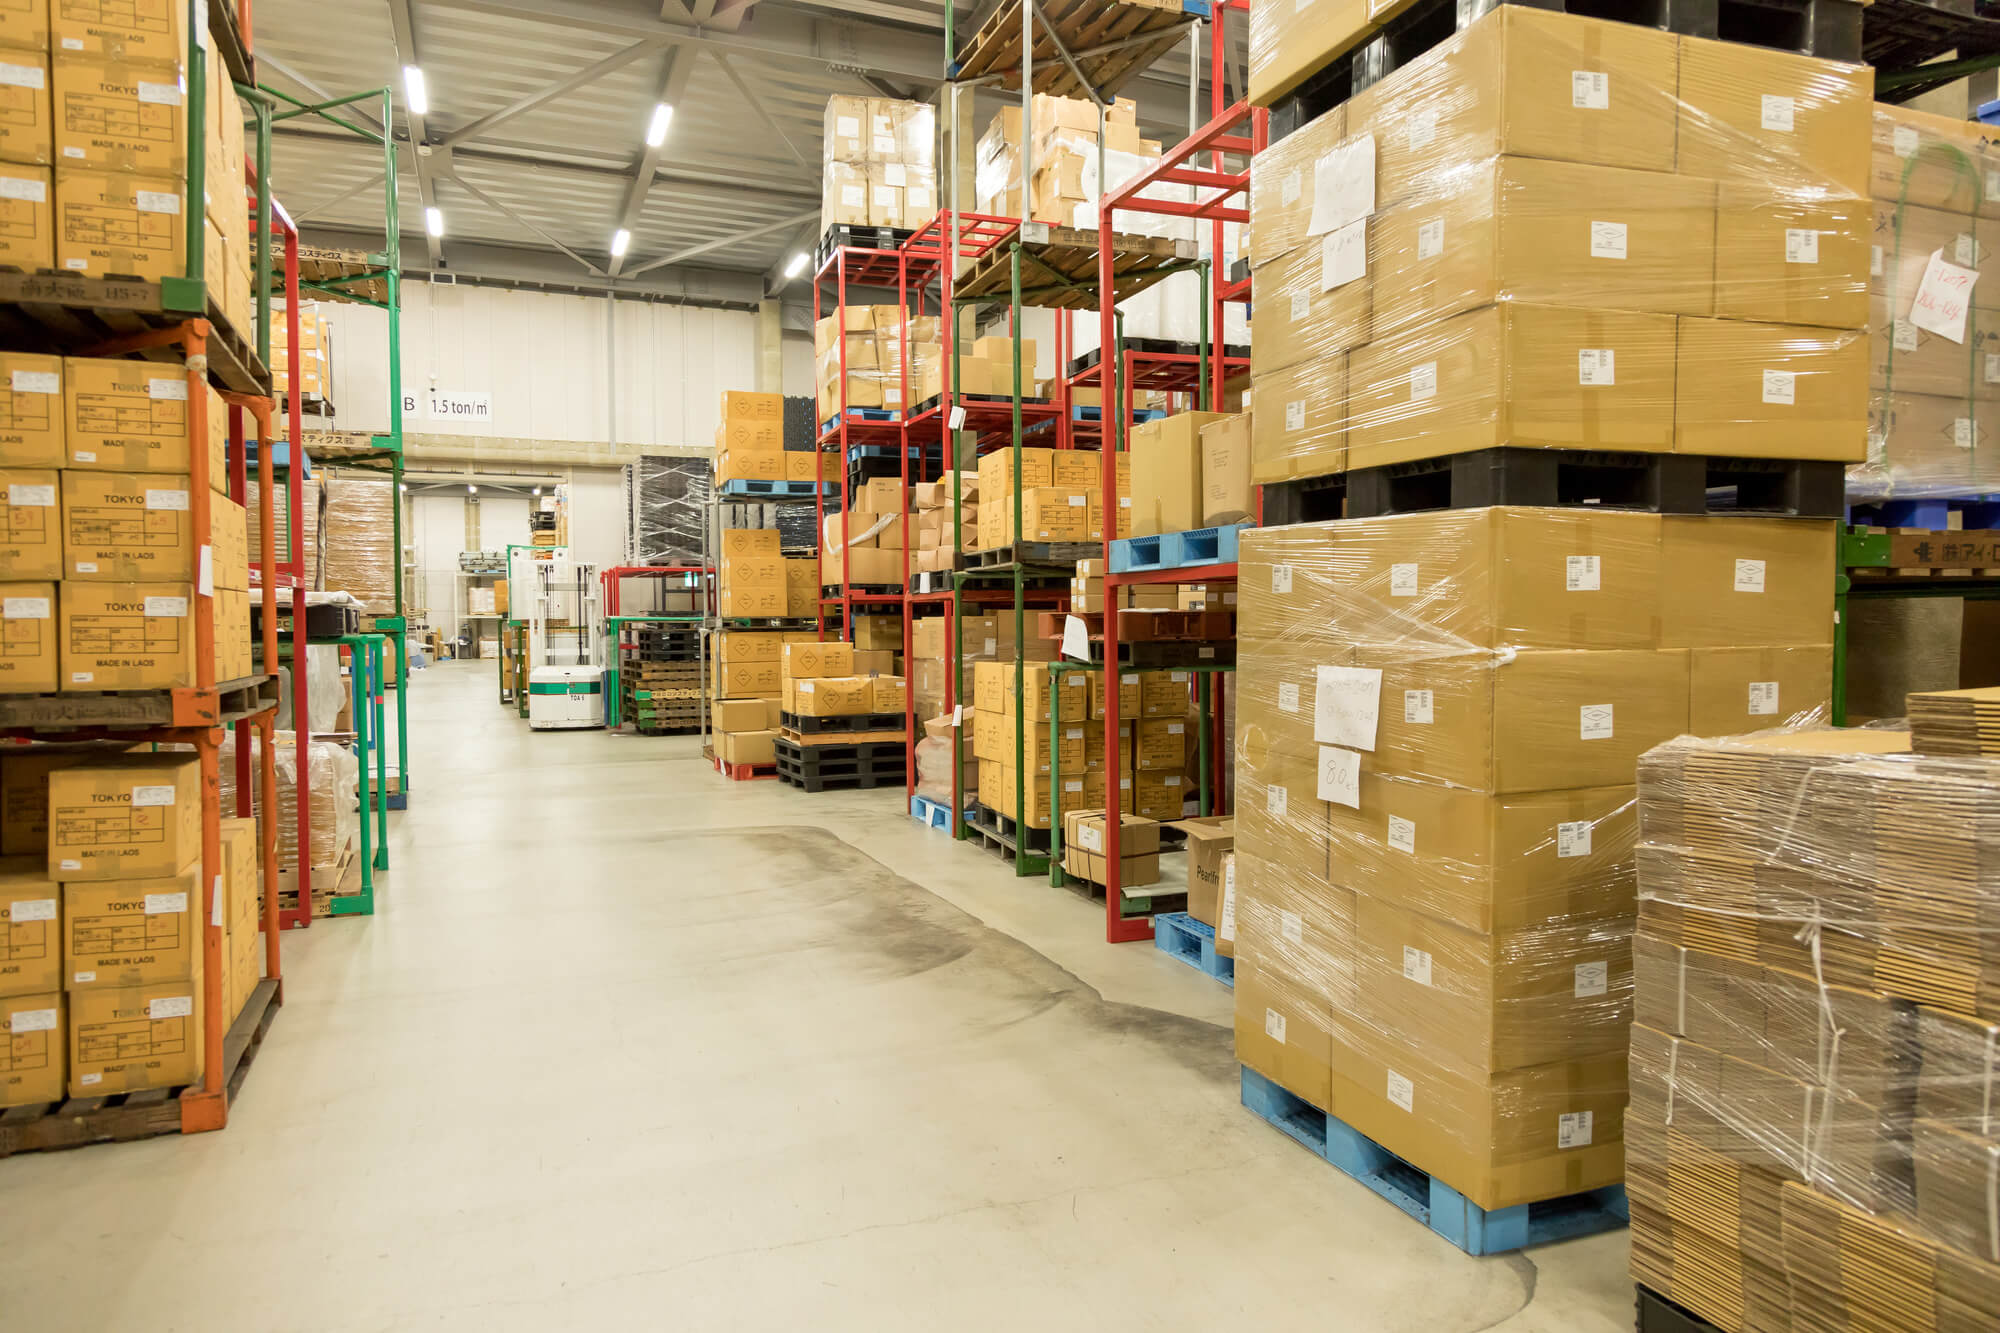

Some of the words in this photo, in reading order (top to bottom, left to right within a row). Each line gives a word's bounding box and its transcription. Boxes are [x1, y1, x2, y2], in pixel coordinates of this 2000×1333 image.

[100, 83, 138, 95] TOKYO
[91, 140, 113, 148] MADE
[127, 144, 150, 152] LAOS
[403, 396, 415, 411] B
[431, 399, 448, 413] 1.5
[104, 495, 144, 504] TOKYO
[104, 602, 144, 611] TOKYO
[132, 659, 155, 667] LAOS
[91, 793, 131, 802] TOKYO
[117, 849, 140, 857] LAOS
[107, 902, 145, 911] TOKYO
[97, 958, 121, 967] MADE
[133, 956, 155, 964] LAOS
